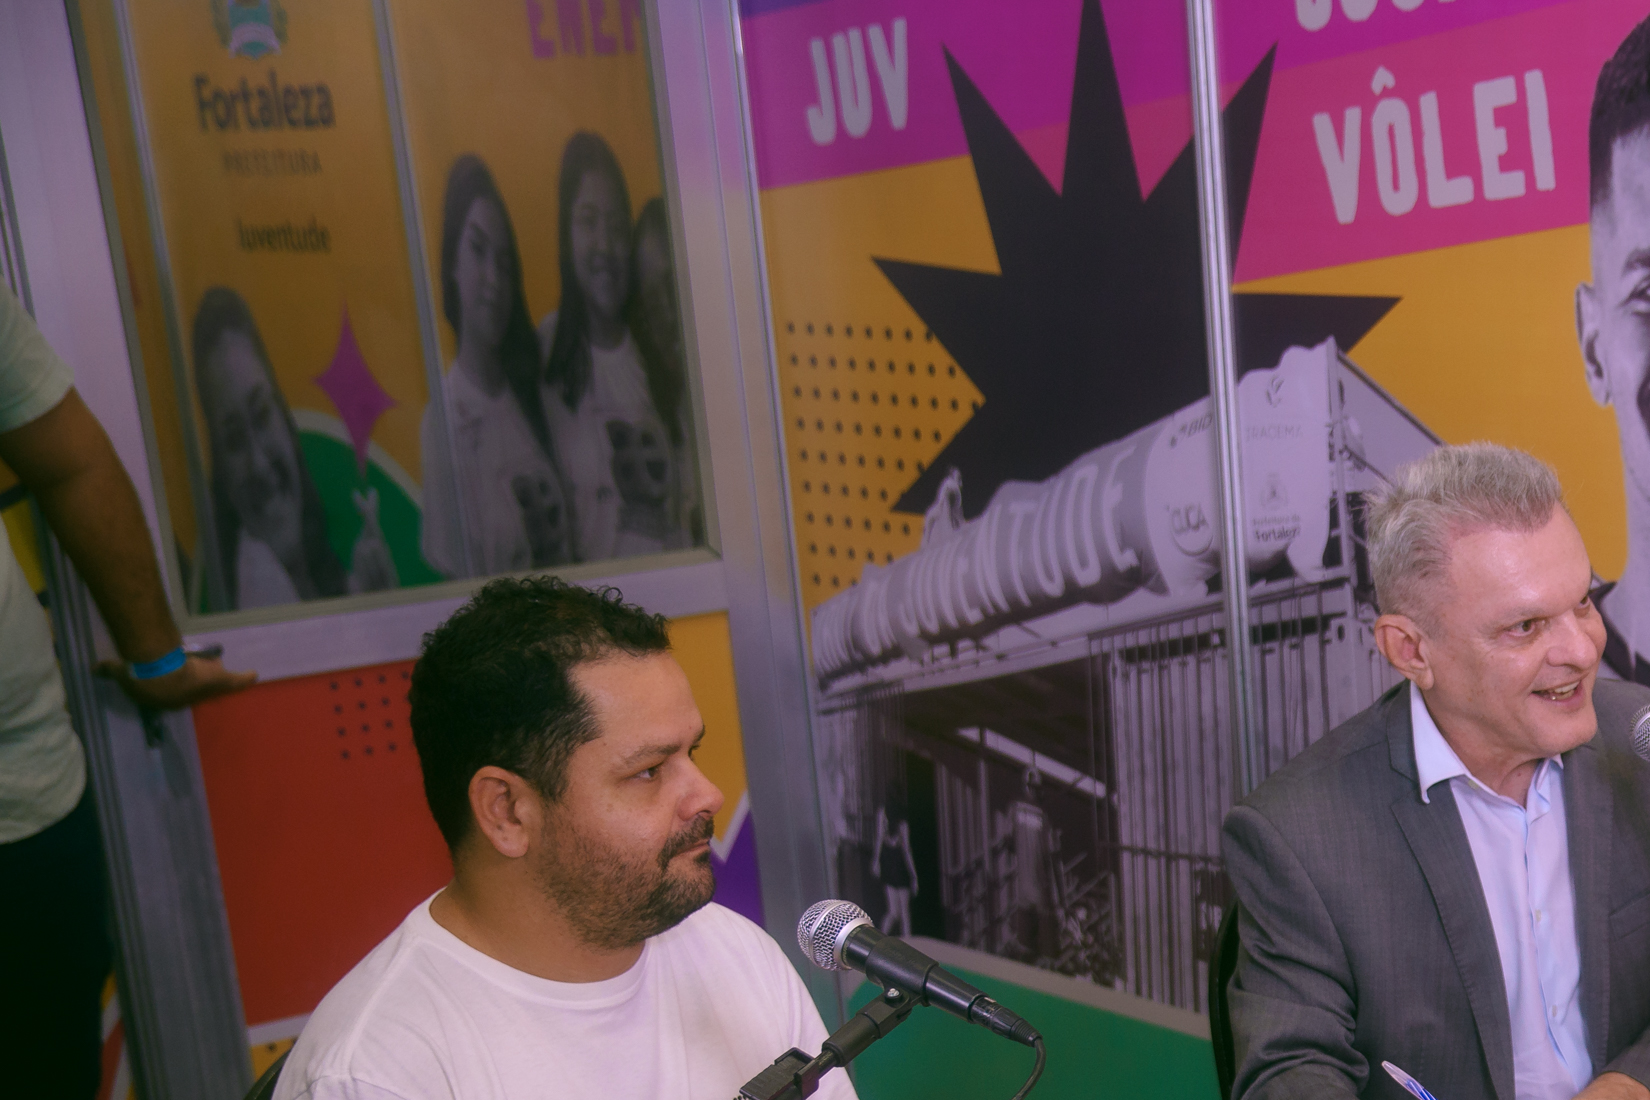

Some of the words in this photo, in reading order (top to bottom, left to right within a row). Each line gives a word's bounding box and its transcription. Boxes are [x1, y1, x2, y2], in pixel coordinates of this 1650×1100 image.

[192, 68, 336, 134] Fortaleza
[806, 16, 909, 146] JUV
[1312, 65, 1556, 225] VÔLEI
